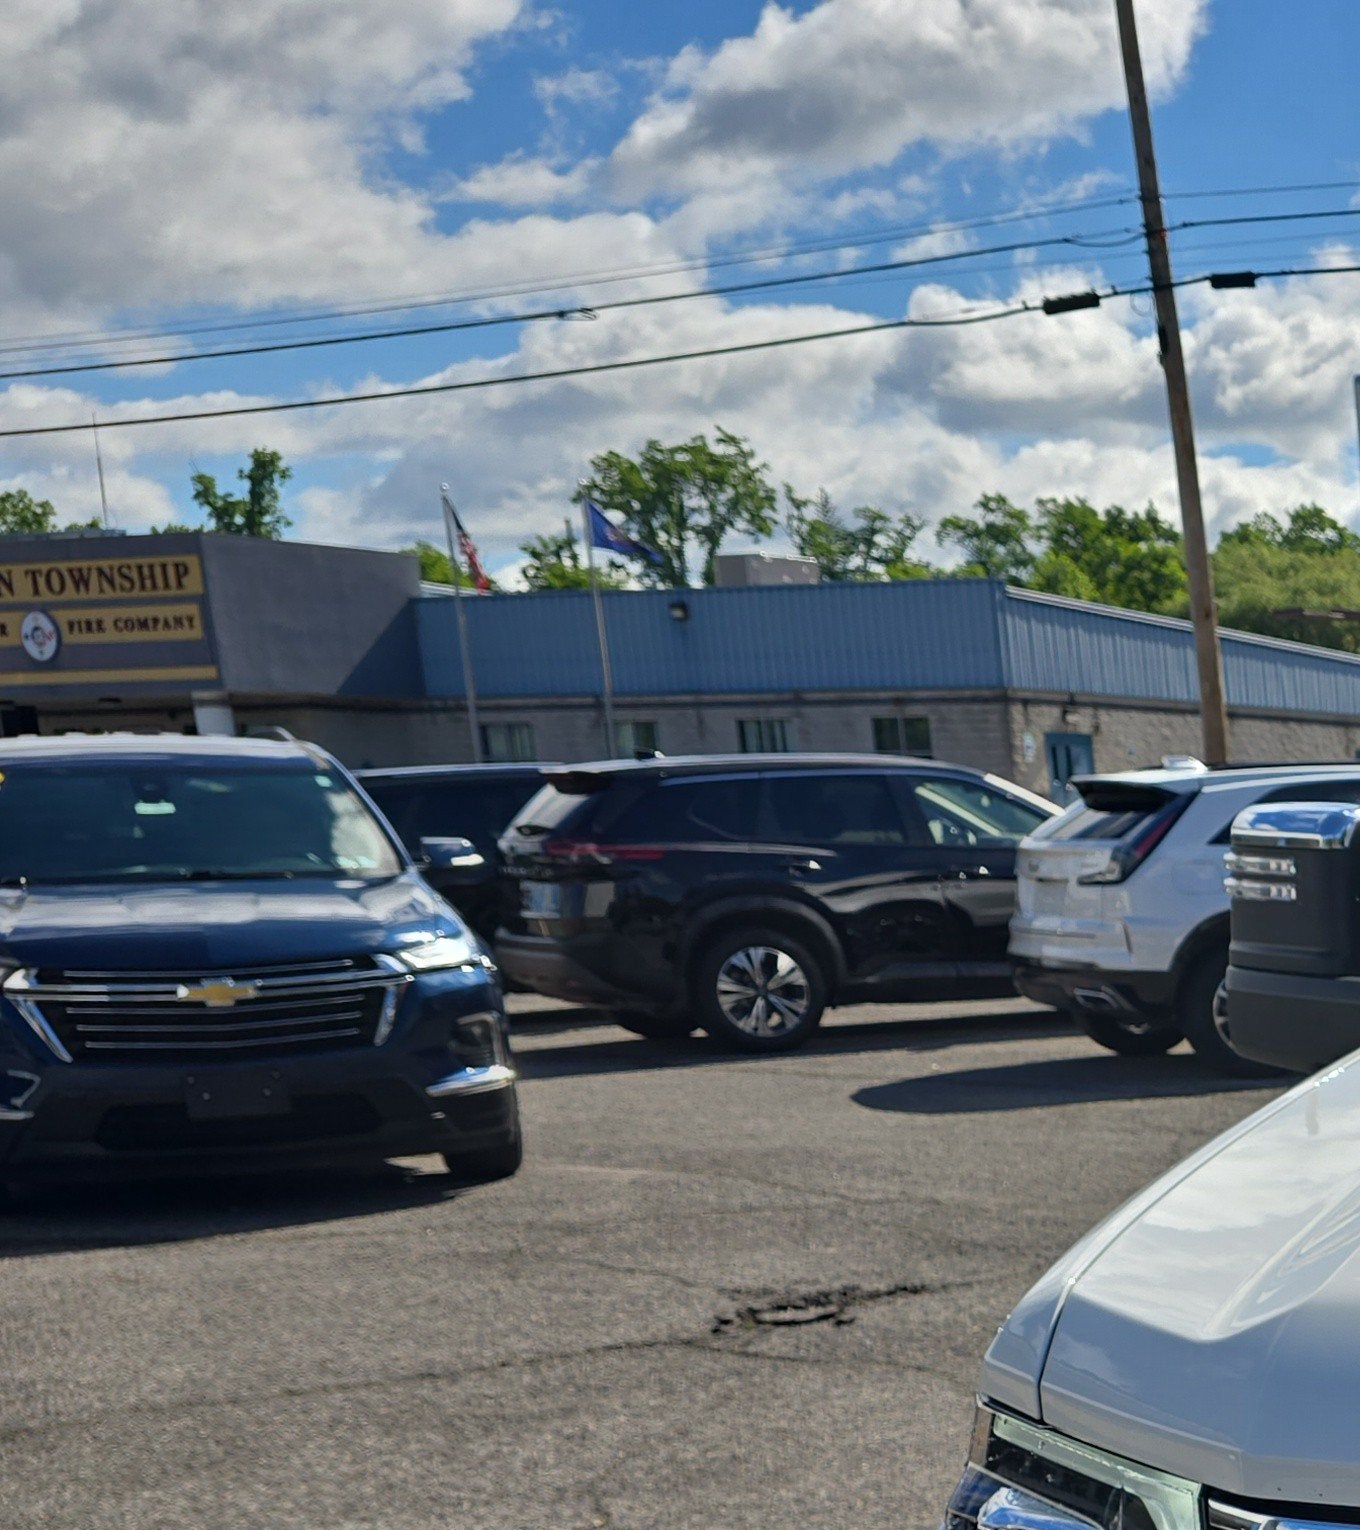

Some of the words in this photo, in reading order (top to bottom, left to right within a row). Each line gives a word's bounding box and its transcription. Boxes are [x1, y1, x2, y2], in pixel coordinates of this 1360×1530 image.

[25, 562, 190, 597] TOWNSHIP
[67, 617, 106, 635] FIRE
[113, 614, 195, 634] COMPANY
